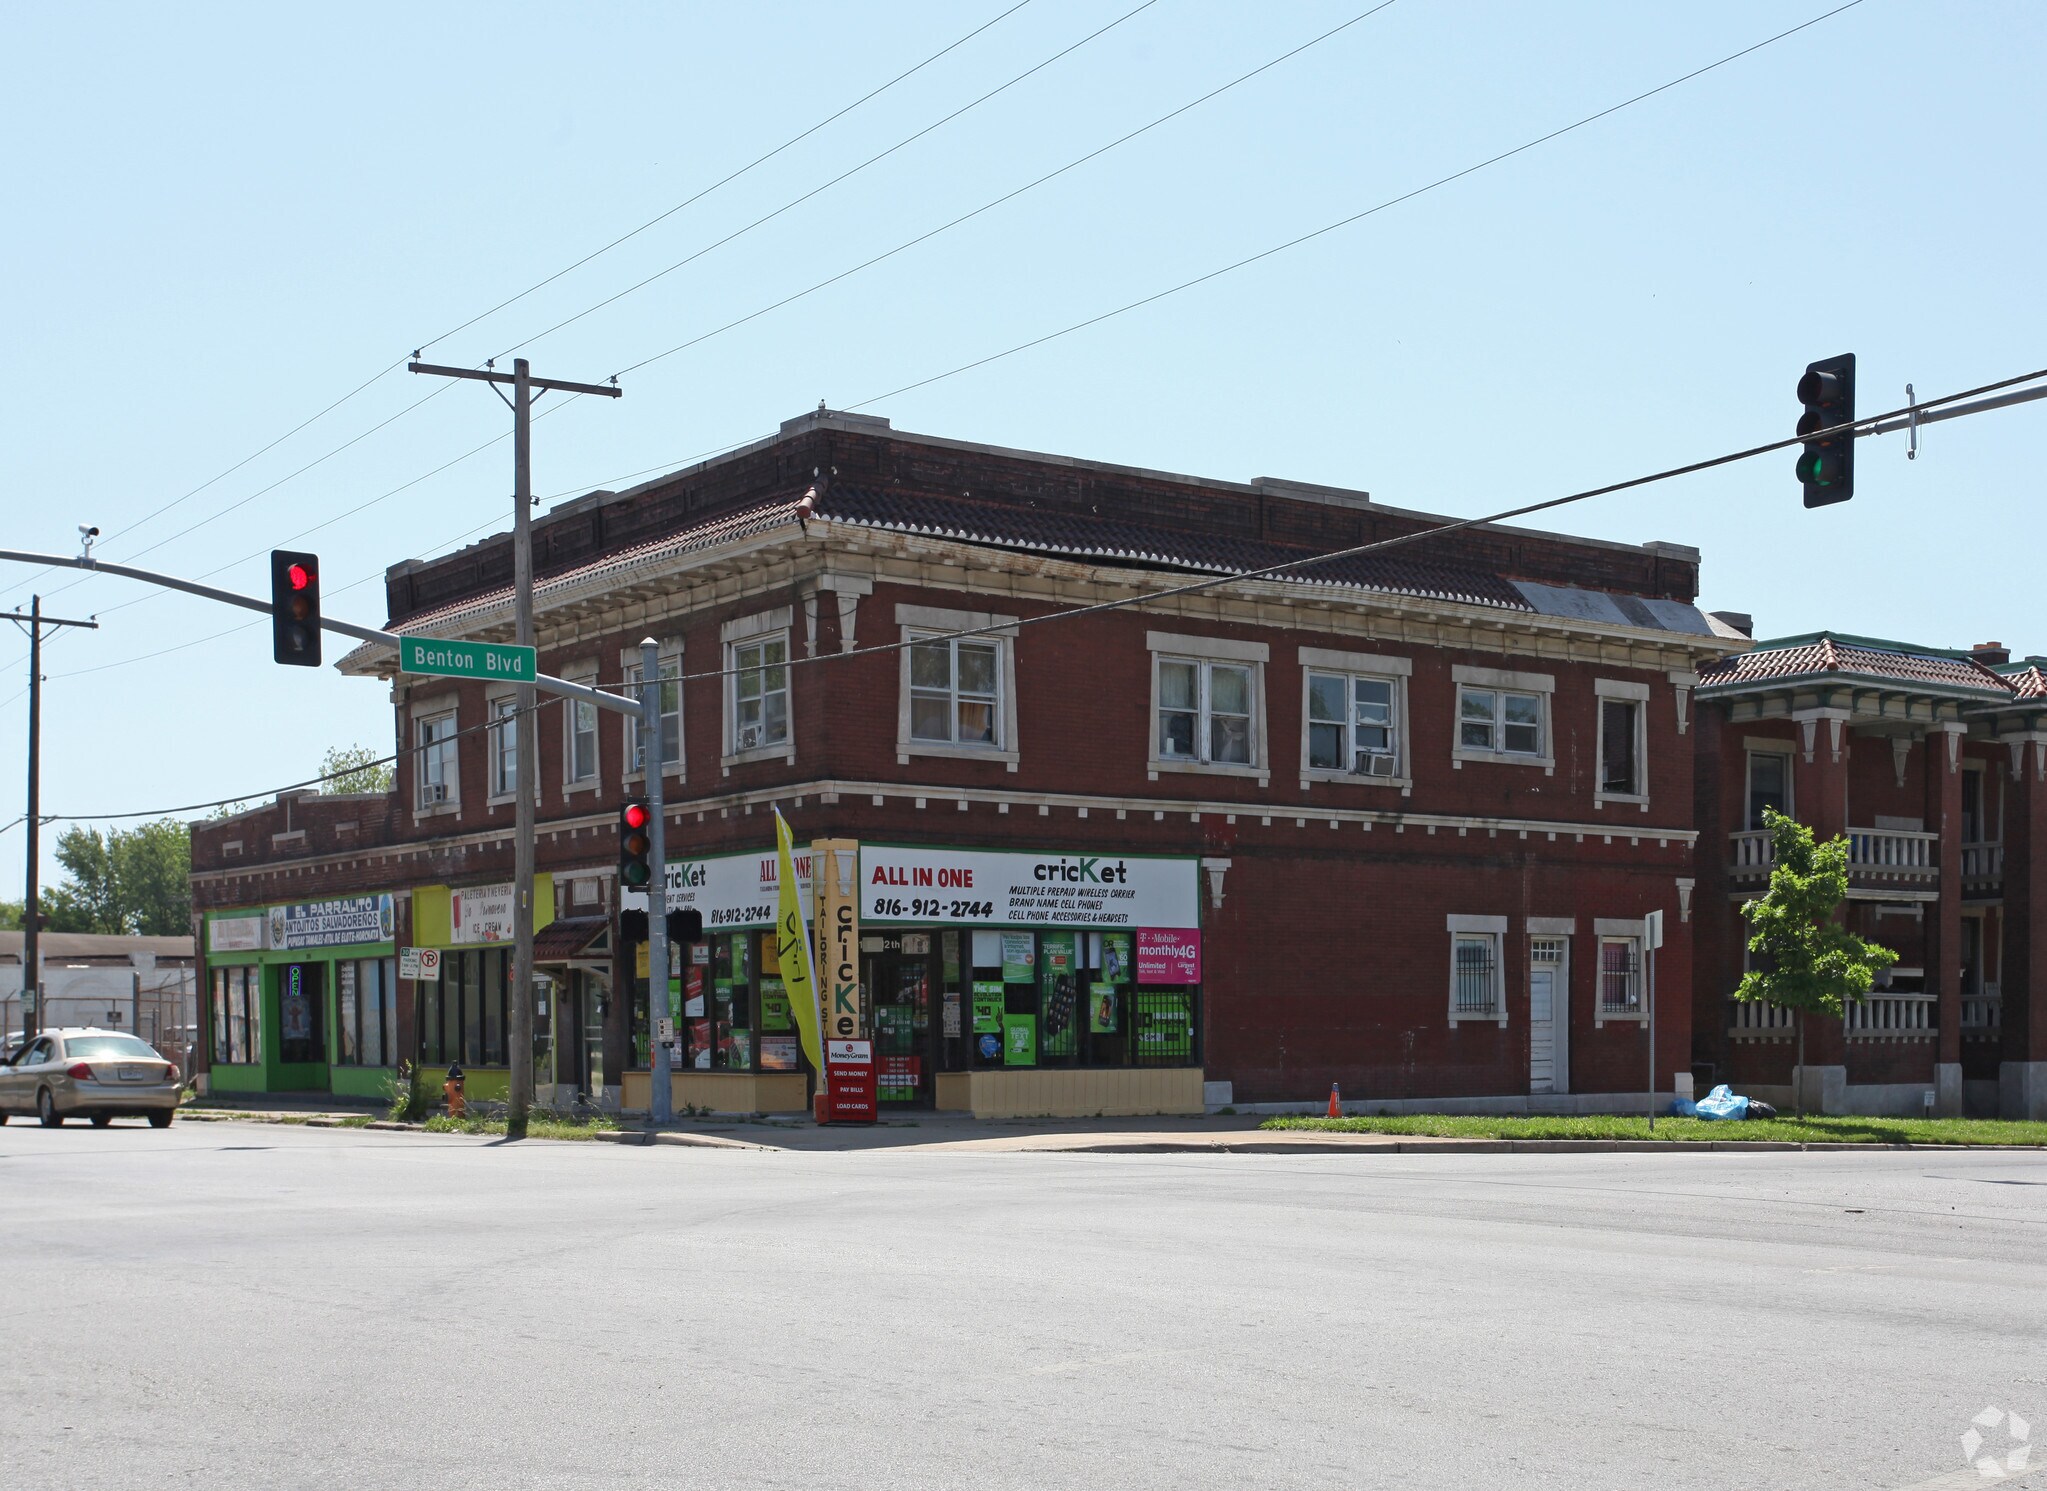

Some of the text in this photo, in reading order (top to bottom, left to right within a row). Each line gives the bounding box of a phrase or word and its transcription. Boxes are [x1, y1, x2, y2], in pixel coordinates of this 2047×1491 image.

[414, 646, 522, 673] Benton Blvd
[665, 863, 706, 889] ricKet
[760, 859, 777, 882] ALL
[872, 866, 973, 888] ALL IN ONE
[1034, 858, 1127, 884] cricKet
[1008, 886, 1136, 899] MULTIPLE PREPAID WIRELESS CARRIER
[295, 897, 373, 918] EL PARRALITO
[711, 905, 771, 924] 816-912-2744
[873, 898, 994, 918] 816-912-2744
[1009, 898, 1104, 910] BRAND NAME CELL PHONES
[285, 912, 378, 933] ANTOJITOS SALVADOREÑOS
[1008, 910, 1129, 923] CELL PHONE ACCESSORIES & HEADSETS
[472, 922, 502, 934] ICE CREAM
[819, 895, 829, 1002] TAILORING
[292, 967, 300, 997] OPEN
[835, 905, 858, 1038] cricKe
